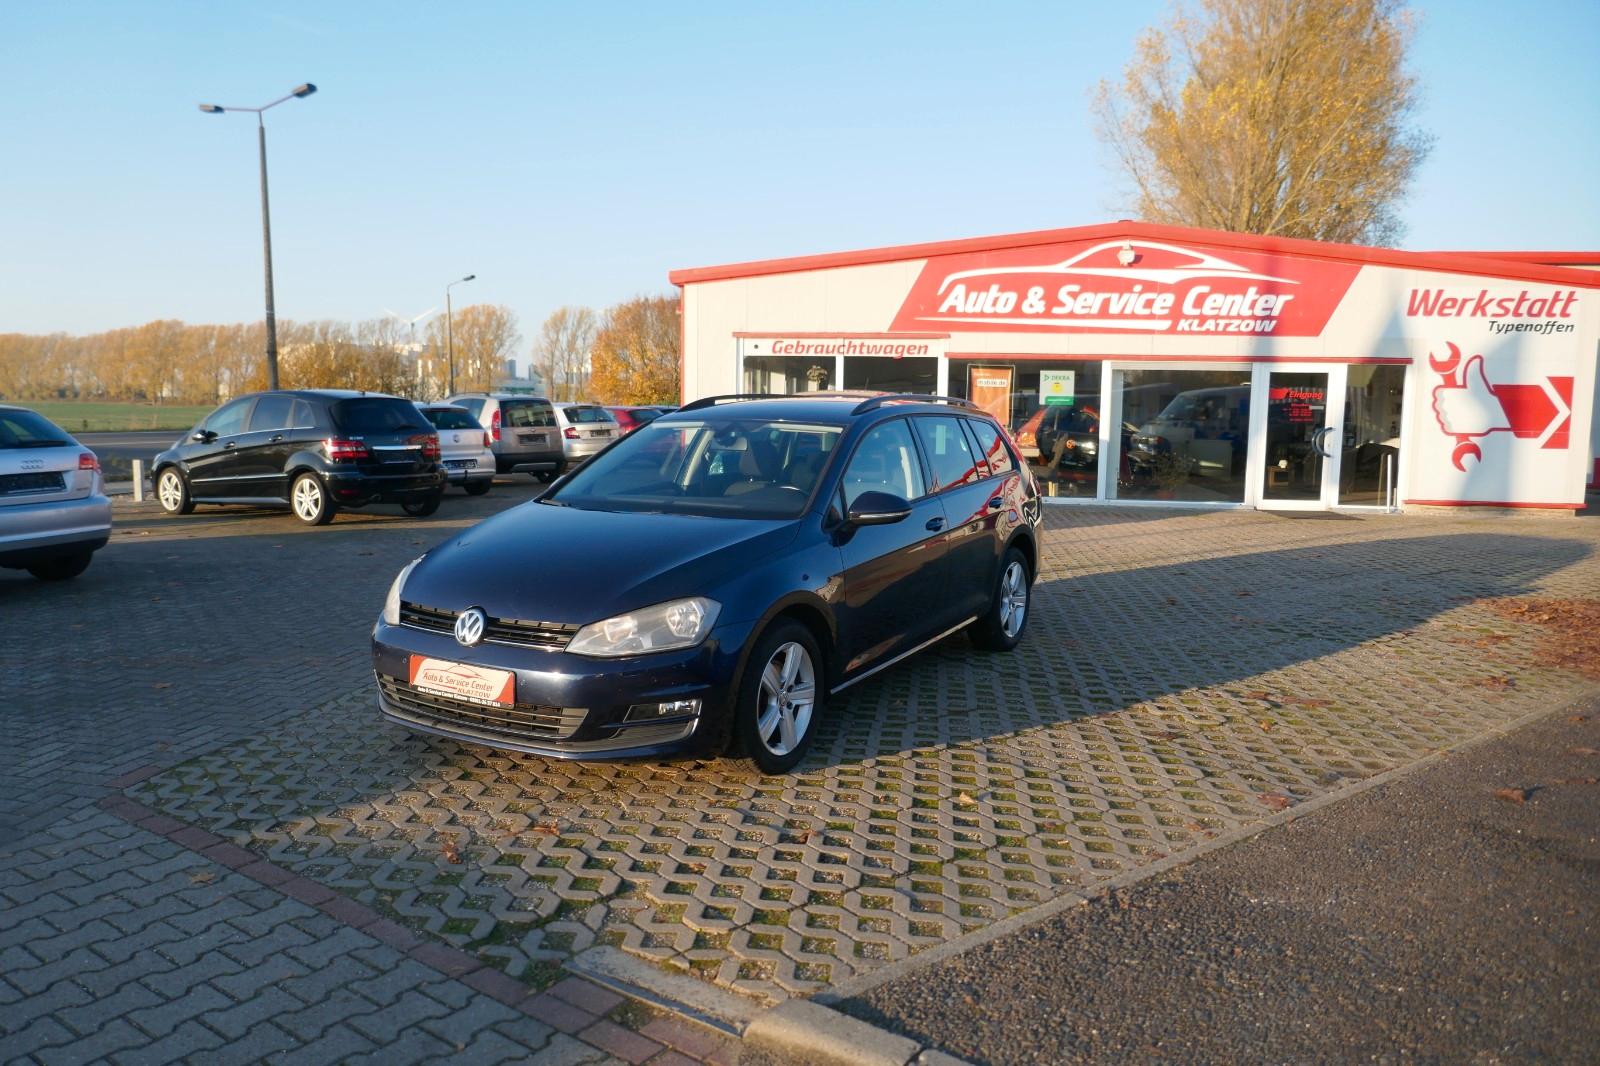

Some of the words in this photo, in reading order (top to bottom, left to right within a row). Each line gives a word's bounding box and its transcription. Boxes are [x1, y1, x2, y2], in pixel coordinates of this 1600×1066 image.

[937, 284, 1018, 314] Auto
[1021, 286, 1046, 315] &
[1051, 284, 1176, 315] Service
[1182, 285, 1295, 317] Center
[1406, 288, 1579, 318] Werkstatt
[1176, 319, 1277, 333] KLATZOW
[1488, 320, 1575, 335] Typenoffen
[771, 340, 929, 360] Gebrauchtwagen
[1289, 390, 1324, 400] Eingang
[423, 672, 438, 682] Auto
[444, 676, 470, 688] Service
[471, 680, 494, 692] Center
